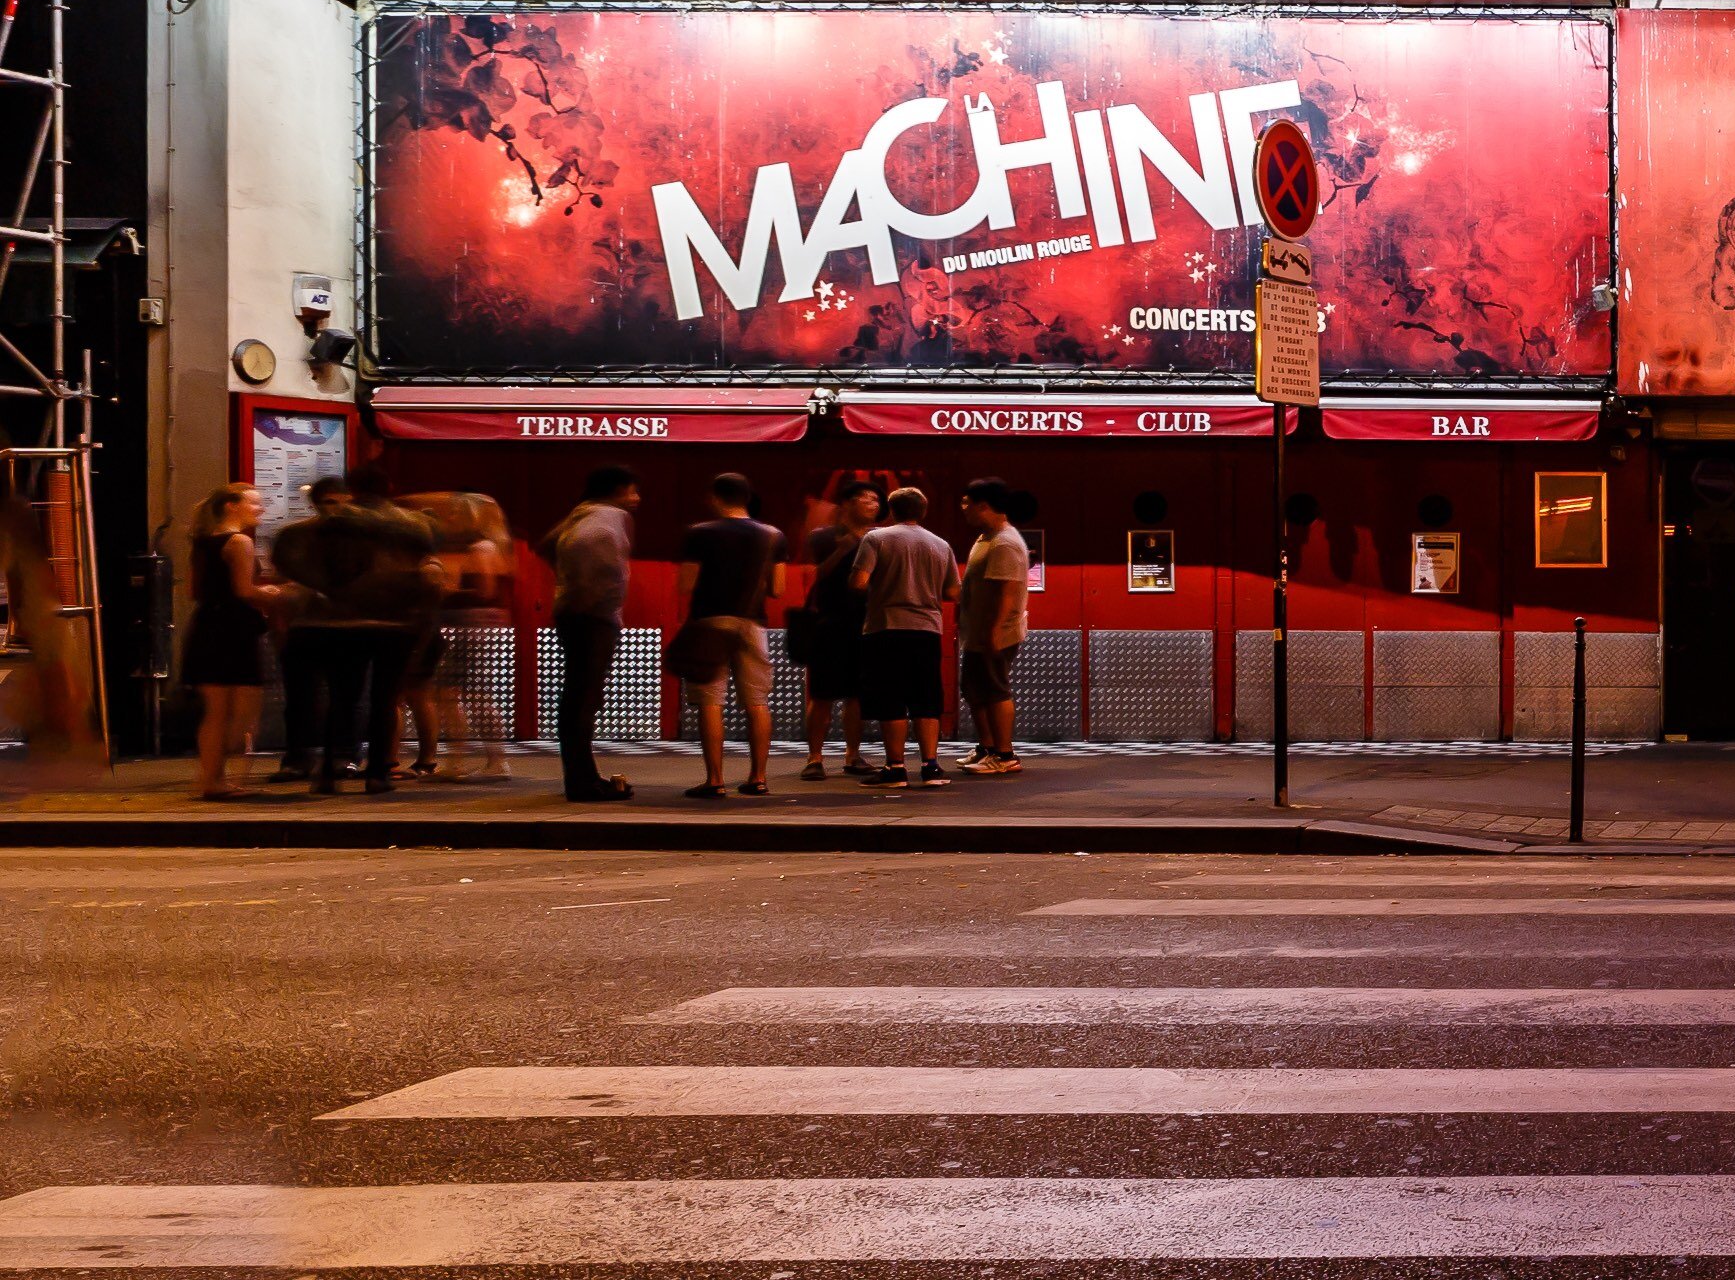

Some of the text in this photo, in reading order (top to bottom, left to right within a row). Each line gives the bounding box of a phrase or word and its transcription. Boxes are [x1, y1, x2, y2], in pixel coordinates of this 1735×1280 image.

[963, 91, 995, 115] LA
[942, 234, 1093, 274] DU MOULIN ROUGE
[1129, 307, 1257, 333] CONCERTS
[517, 415, 669, 438] TERRASSE
[931, 409, 1083, 432] CONCERTS
[1137, 409, 1212, 432] CLUB
[1431, 416, 1491, 437] BAR
